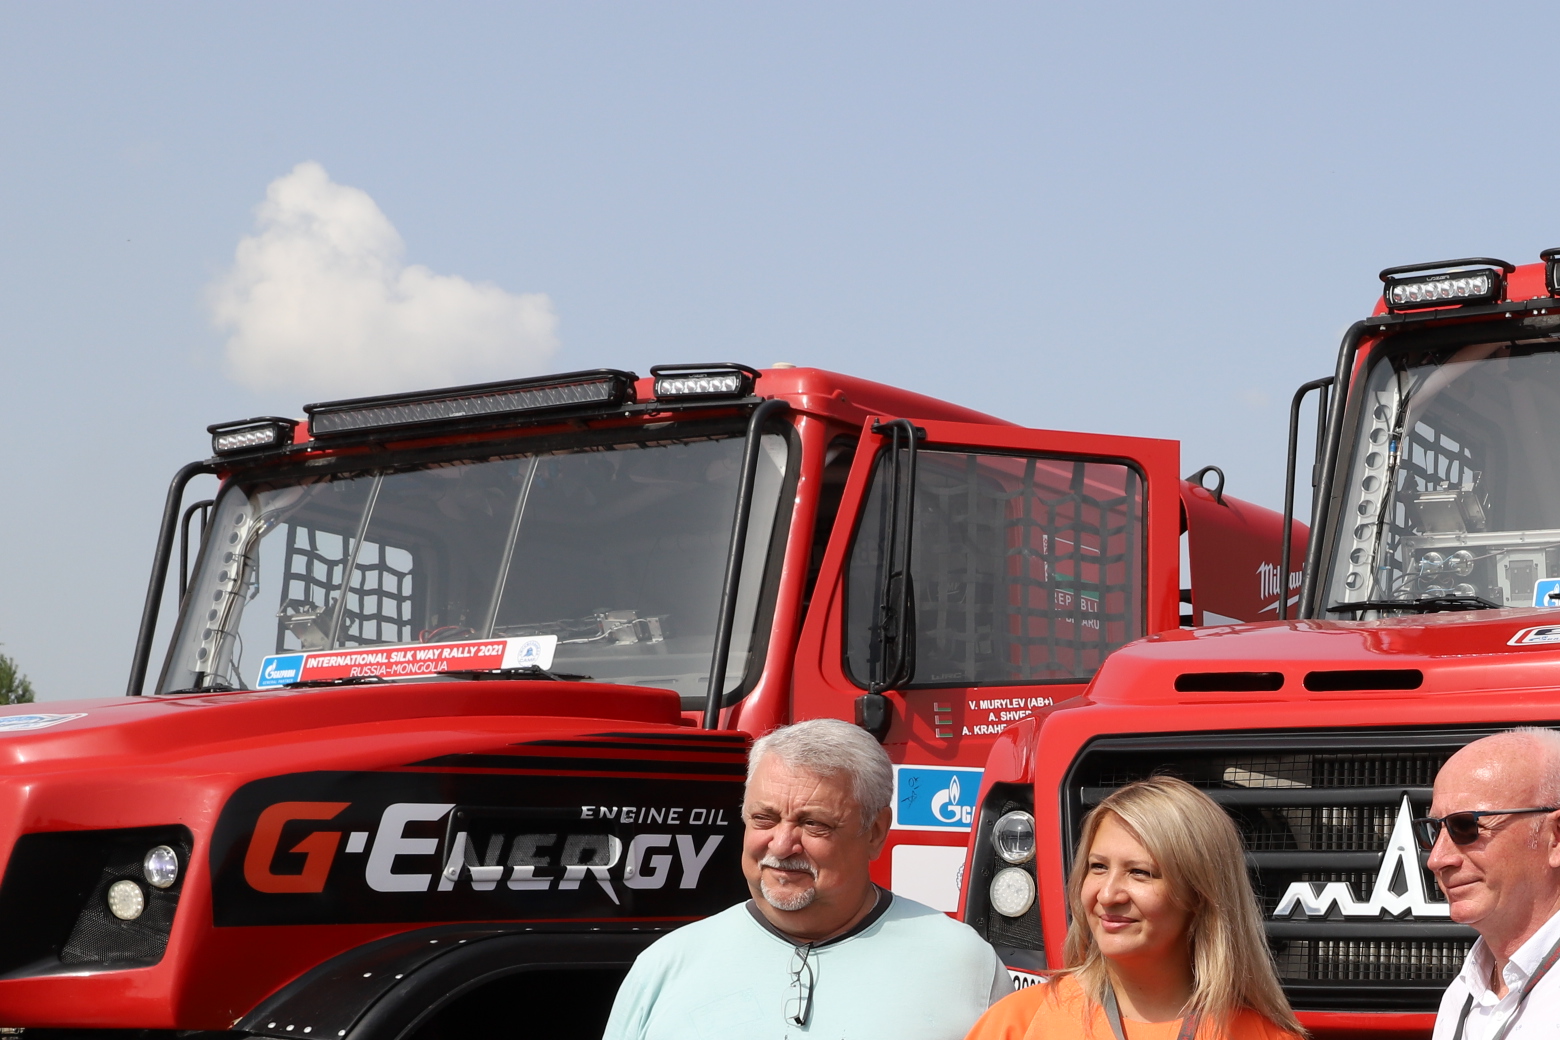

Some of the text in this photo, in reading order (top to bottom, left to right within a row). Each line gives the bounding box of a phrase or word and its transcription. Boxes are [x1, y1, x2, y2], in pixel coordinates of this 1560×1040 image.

[1256, 561, 1305, 600] Milau
[307, 644, 503, 668] INTERNATIONAL SILK WAY RALLY 2021
[969, 701, 978, 710] V.
[980, 698, 1025, 710] MURYLEV
[988, 712, 998, 721] A.
[962, 726, 972, 735] A.
[580, 805, 729, 826] ENGINE OIL
